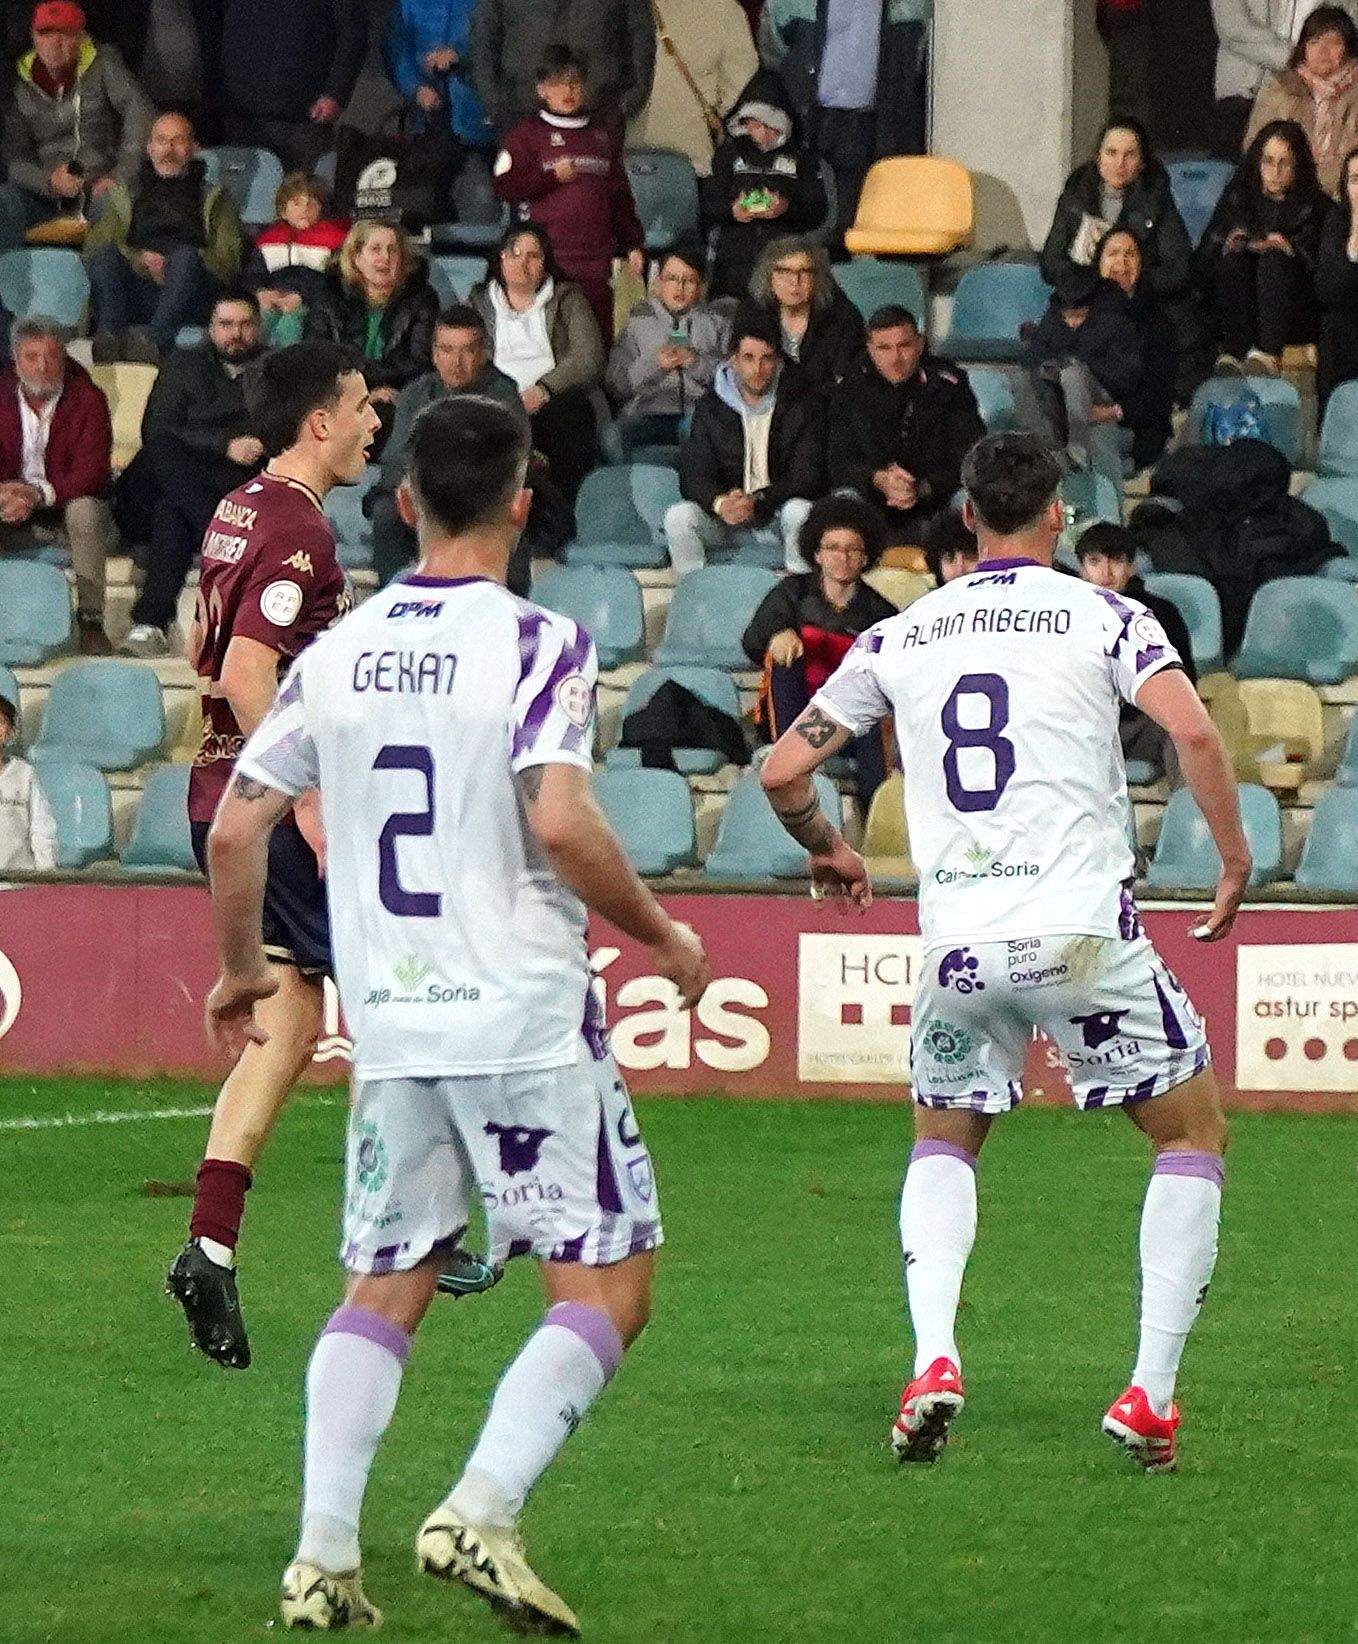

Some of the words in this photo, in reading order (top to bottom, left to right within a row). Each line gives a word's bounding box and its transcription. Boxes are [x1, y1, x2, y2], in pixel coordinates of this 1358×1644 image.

[903, 612, 964, 649] ALAIN
[972, 608, 1071, 635] RIBEIRO
[941, 672, 1016, 813] 8
[372, 745, 443, 917] 2
[991, 861, 1040, 877] Soria
[1007, 938, 1041, 953] Soria
[1008, 951, 1037, 969] puro
[1258, 971, 1305, 987] HOTEL
[427, 983, 480, 1003] Soria
[1254, 996, 1320, 1017] astur
[1067, 1040, 1141, 1069] Soria
[481, 1176, 564, 1211] Soria
